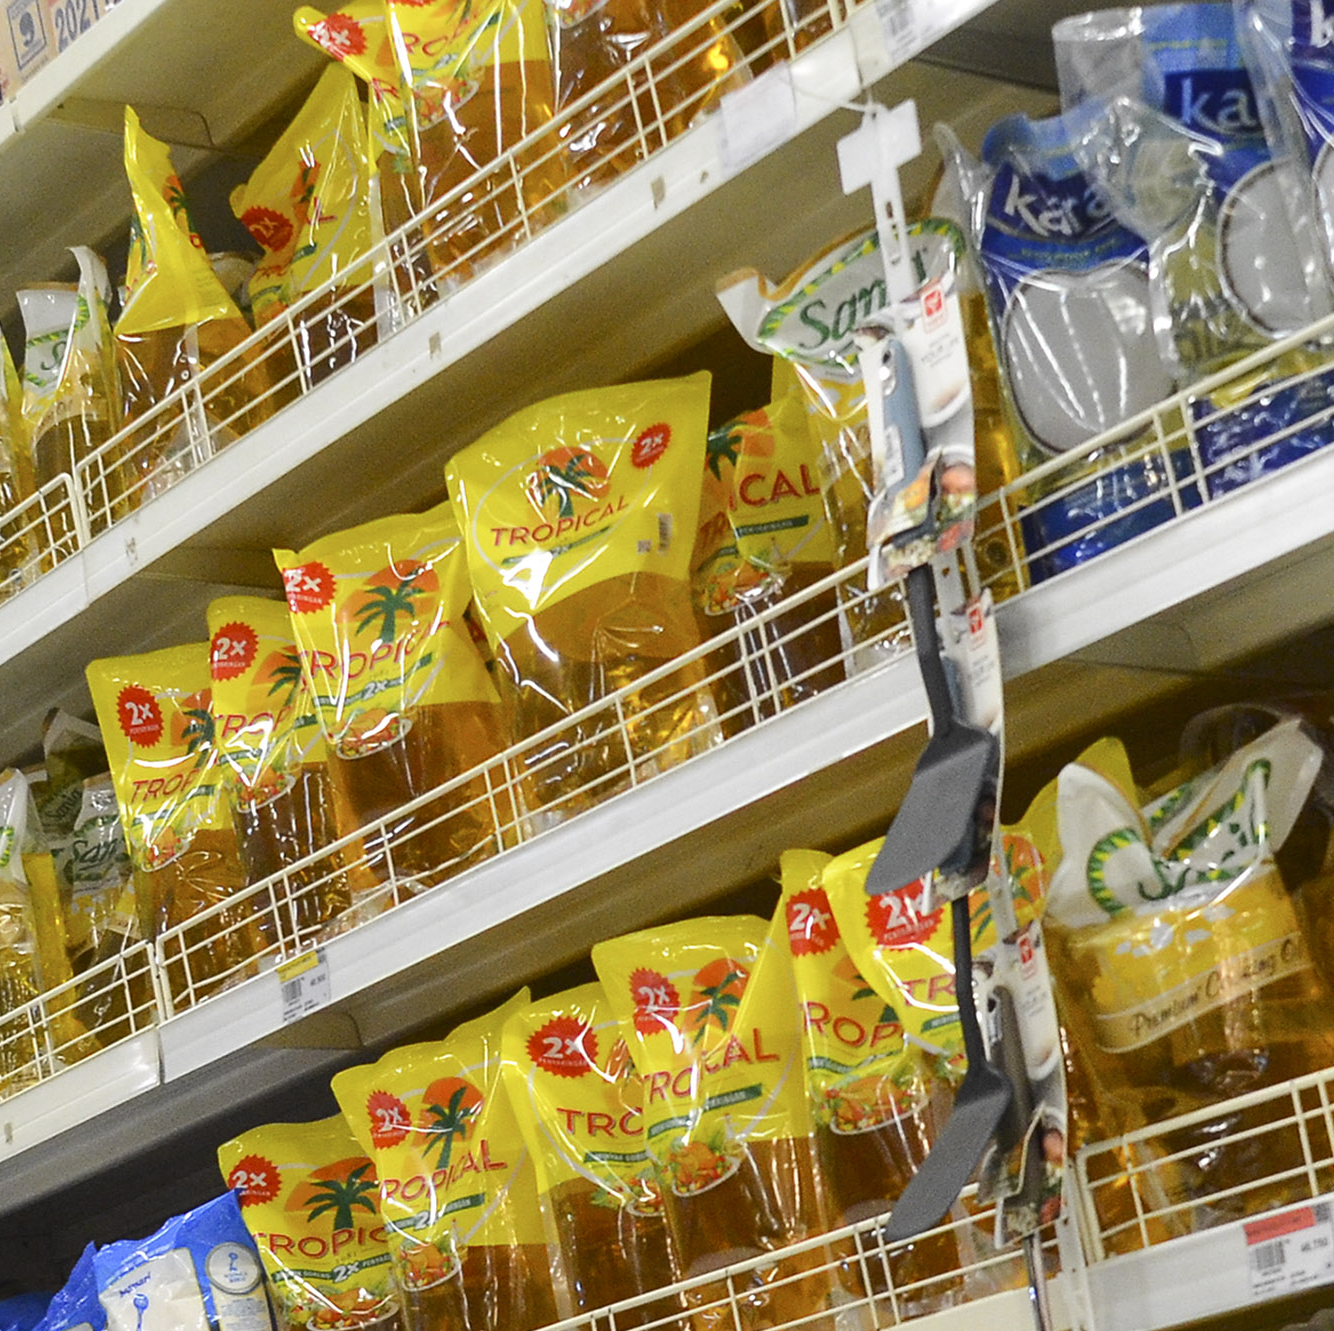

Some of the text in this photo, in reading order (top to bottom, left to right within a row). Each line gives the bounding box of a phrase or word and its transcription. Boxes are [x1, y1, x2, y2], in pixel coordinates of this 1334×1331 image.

[18, 11, 36, 47] 9
[640, 430, 665, 455] 2x
[491, 494, 630, 548] TROPICAL
[285, 569, 321, 593] 2x
[215, 634, 246, 660] 2x
[129, 701, 155, 727] 2x
[790, 903, 831, 931] 2x
[639, 985, 670, 1013] 2x
[542, 1036, 582, 1060] 2x
[376, 1107, 403, 1132] 2x
[232, 1170, 267, 1189] 2x
[333, 1261, 359, 1283] 2x
